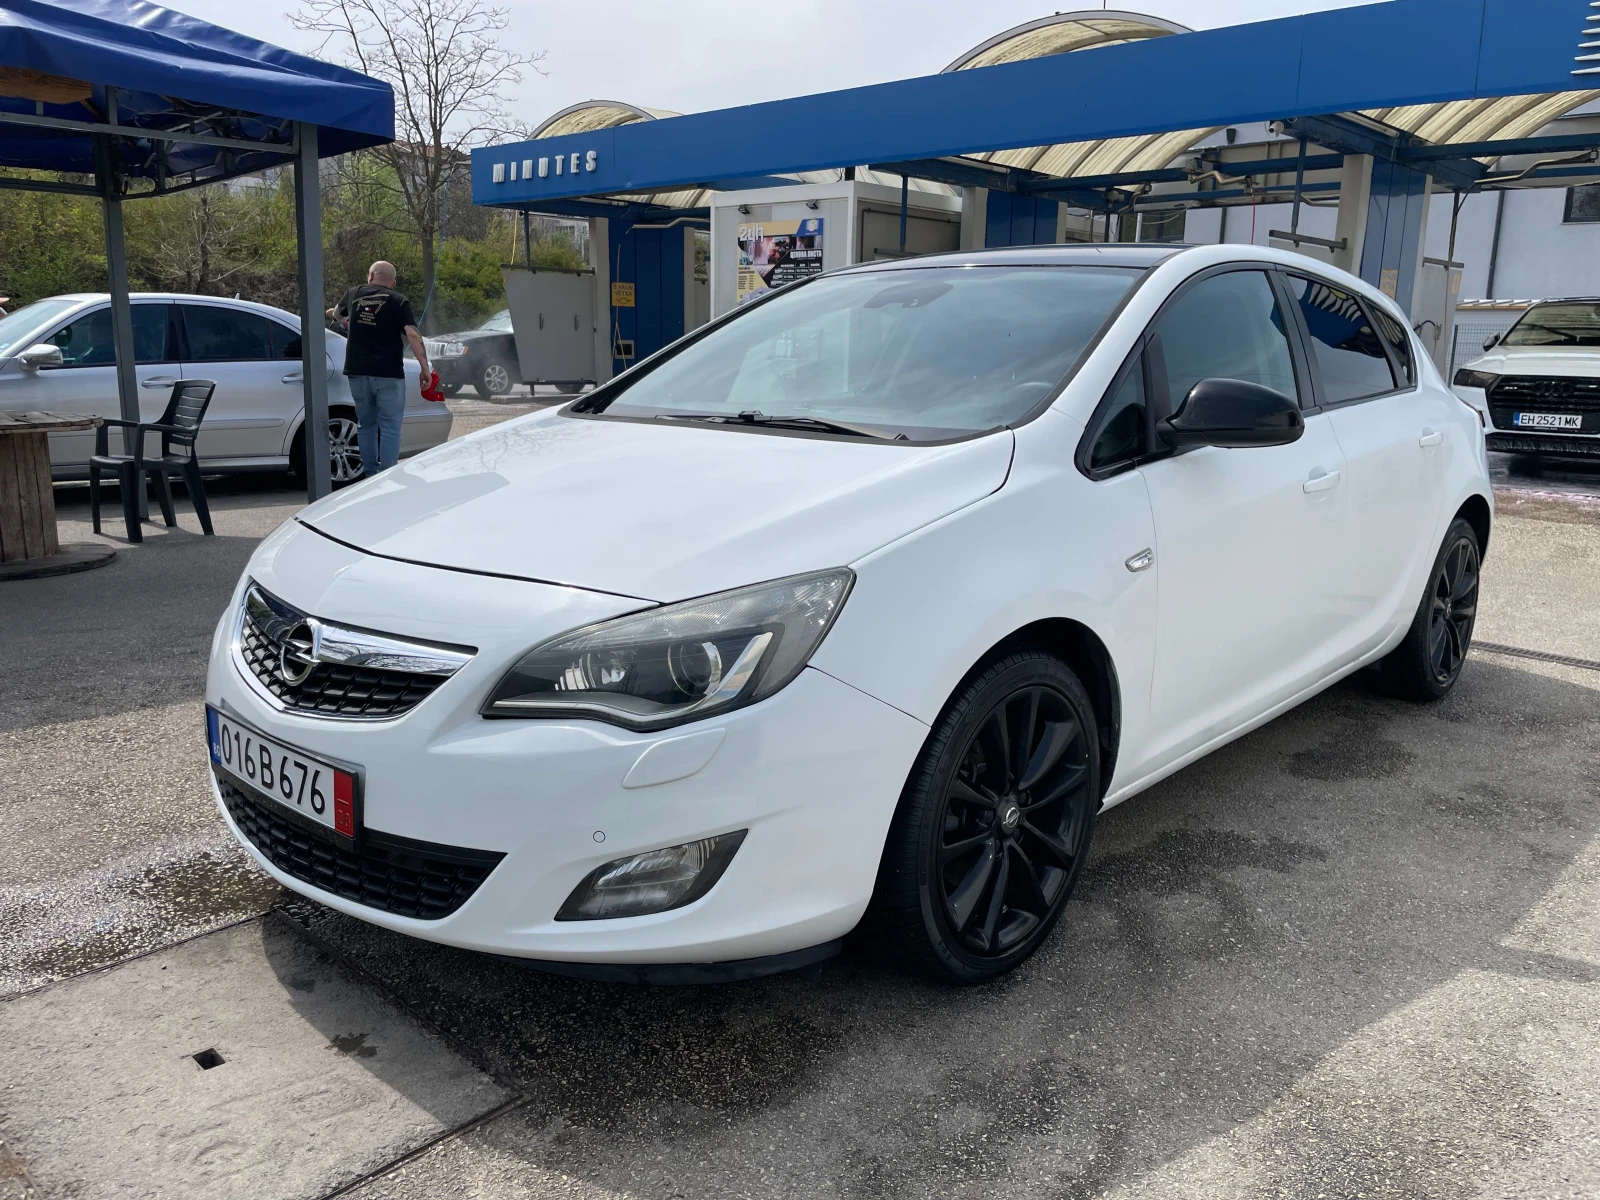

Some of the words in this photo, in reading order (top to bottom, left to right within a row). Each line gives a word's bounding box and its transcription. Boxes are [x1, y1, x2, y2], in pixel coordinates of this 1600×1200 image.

[493, 150, 597, 183] MINUTES
[740, 223, 764, 242] 24h
[1520, 414, 1535, 425] EH
[1537, 415, 1562, 426] 2521
[1564, 416, 1579, 427] MK
